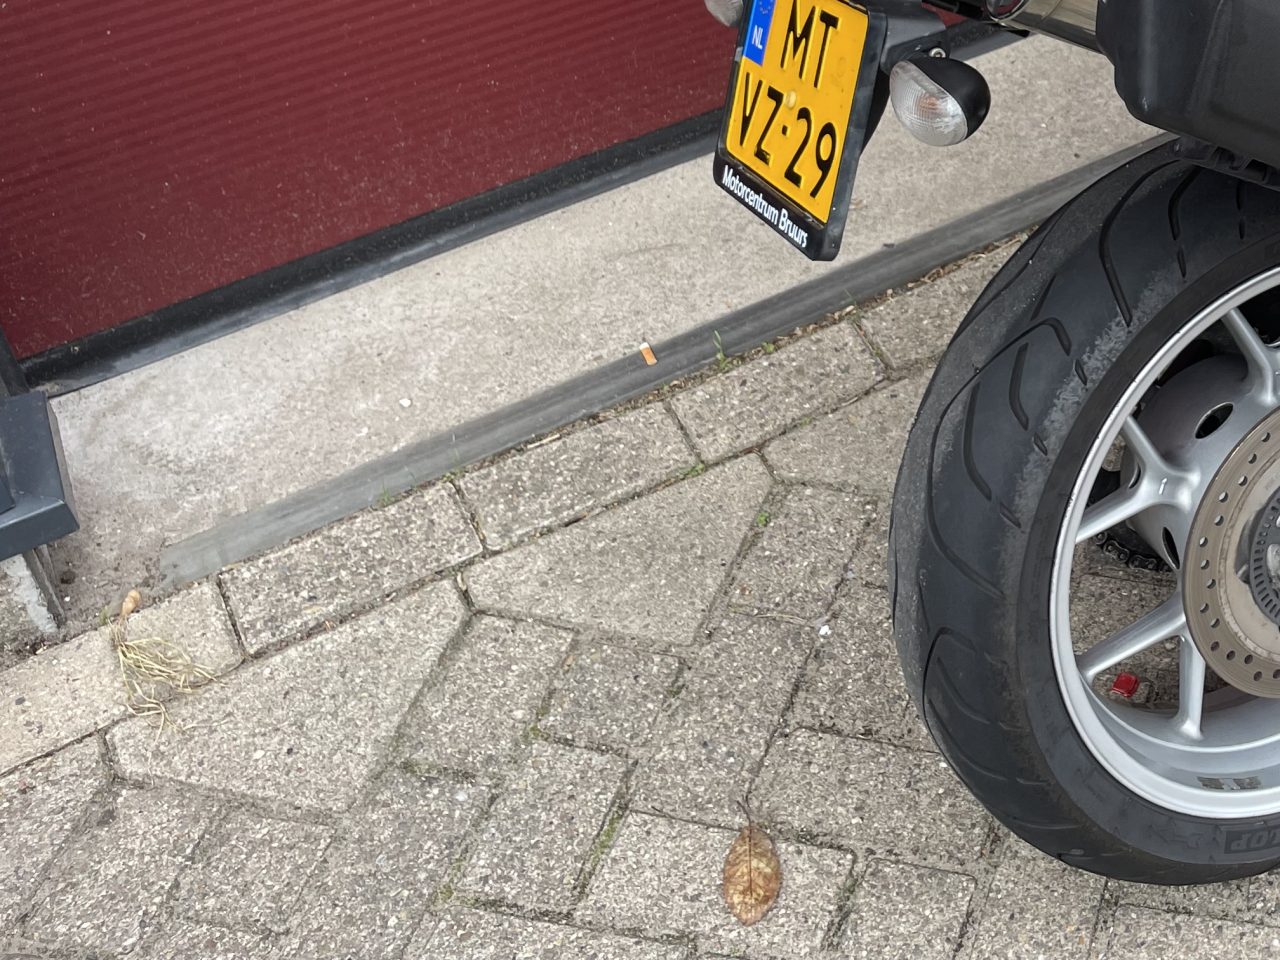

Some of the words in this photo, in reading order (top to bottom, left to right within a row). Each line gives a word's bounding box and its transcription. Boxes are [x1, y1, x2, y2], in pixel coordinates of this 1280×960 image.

[751, 25, 763, 50] NL
[722, 164, 779, 225] Motorcentrum
[778, 208, 809, 248] Bruurs
